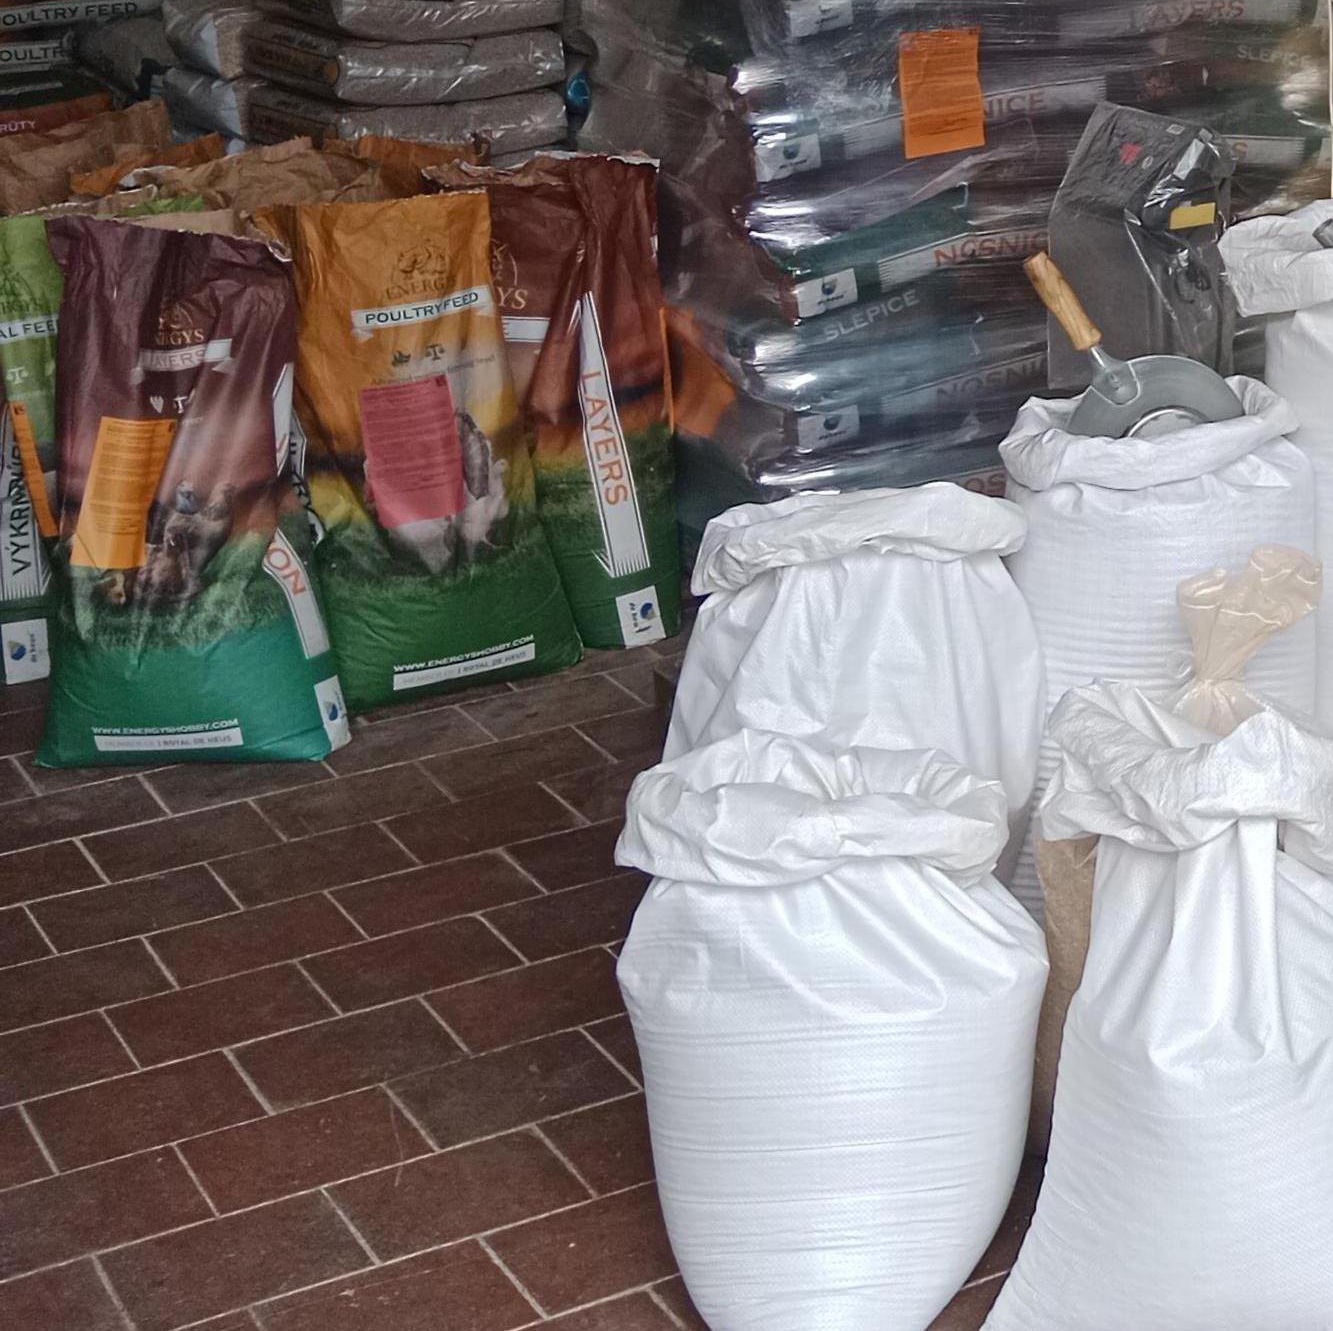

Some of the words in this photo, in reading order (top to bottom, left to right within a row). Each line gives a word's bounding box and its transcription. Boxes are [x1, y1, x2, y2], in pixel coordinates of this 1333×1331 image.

[2, 6, 79, 26] OULTRY
[85, 1, 138, 17] FEED
[0, 47, 65, 63] OULTR
[934, 232, 1048, 267] NOSNIC
[365, 301, 444, 325] POULTRY
[443, 291, 479, 309] FEED
[23, 318, 58, 337] FEE
[582, 371, 630, 507] LAYERS
[393, 633, 536, 673] WWW.ENERGYSHOBBY.COM
[91, 718, 240, 735] WWW.ENERGYSHOBBY.COM
